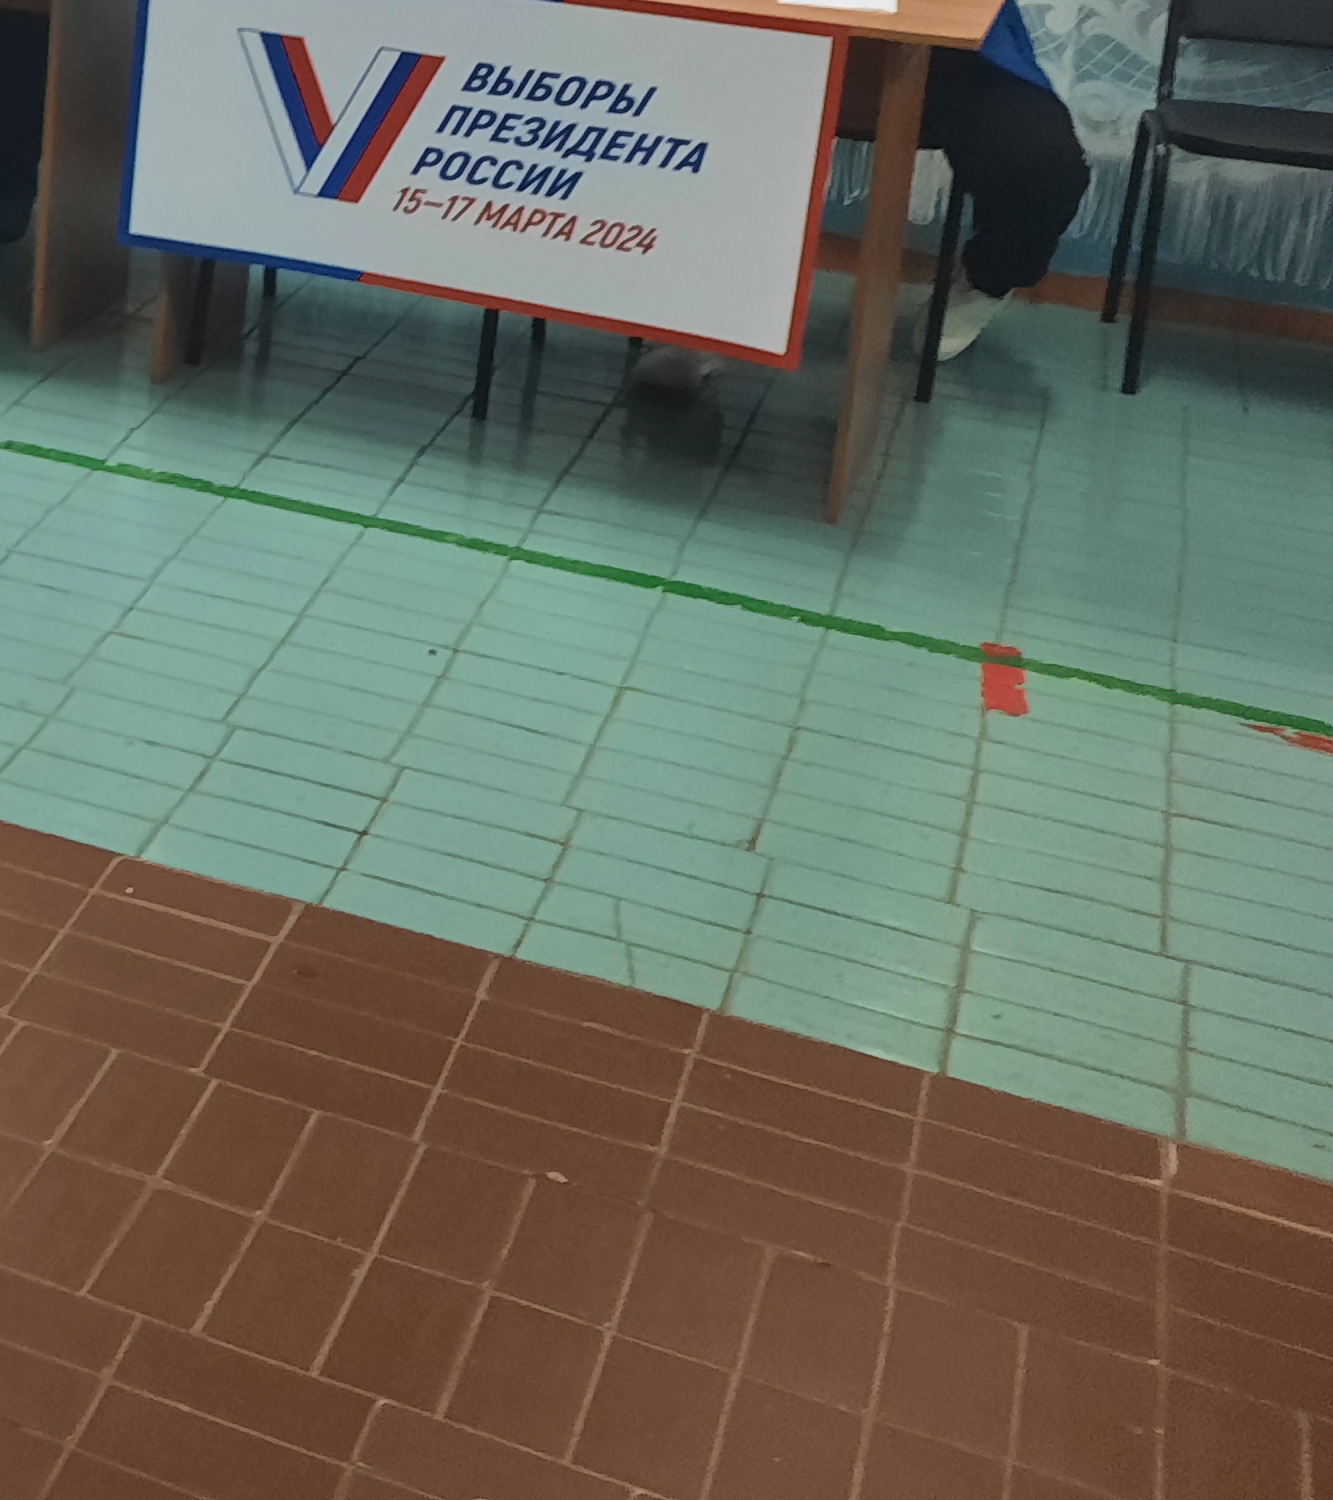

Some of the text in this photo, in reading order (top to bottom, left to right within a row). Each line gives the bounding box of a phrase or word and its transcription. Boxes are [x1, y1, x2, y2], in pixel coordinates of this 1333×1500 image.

[461, 62, 658, 118] ВЫБОРЫ
[435, 104, 710, 174] ПРЕЗИДЕНТА
[411, 147, 584, 201] РОССИИ
[477, 199, 578, 242] МАРТА
[578, 218, 659, 255] 2024
